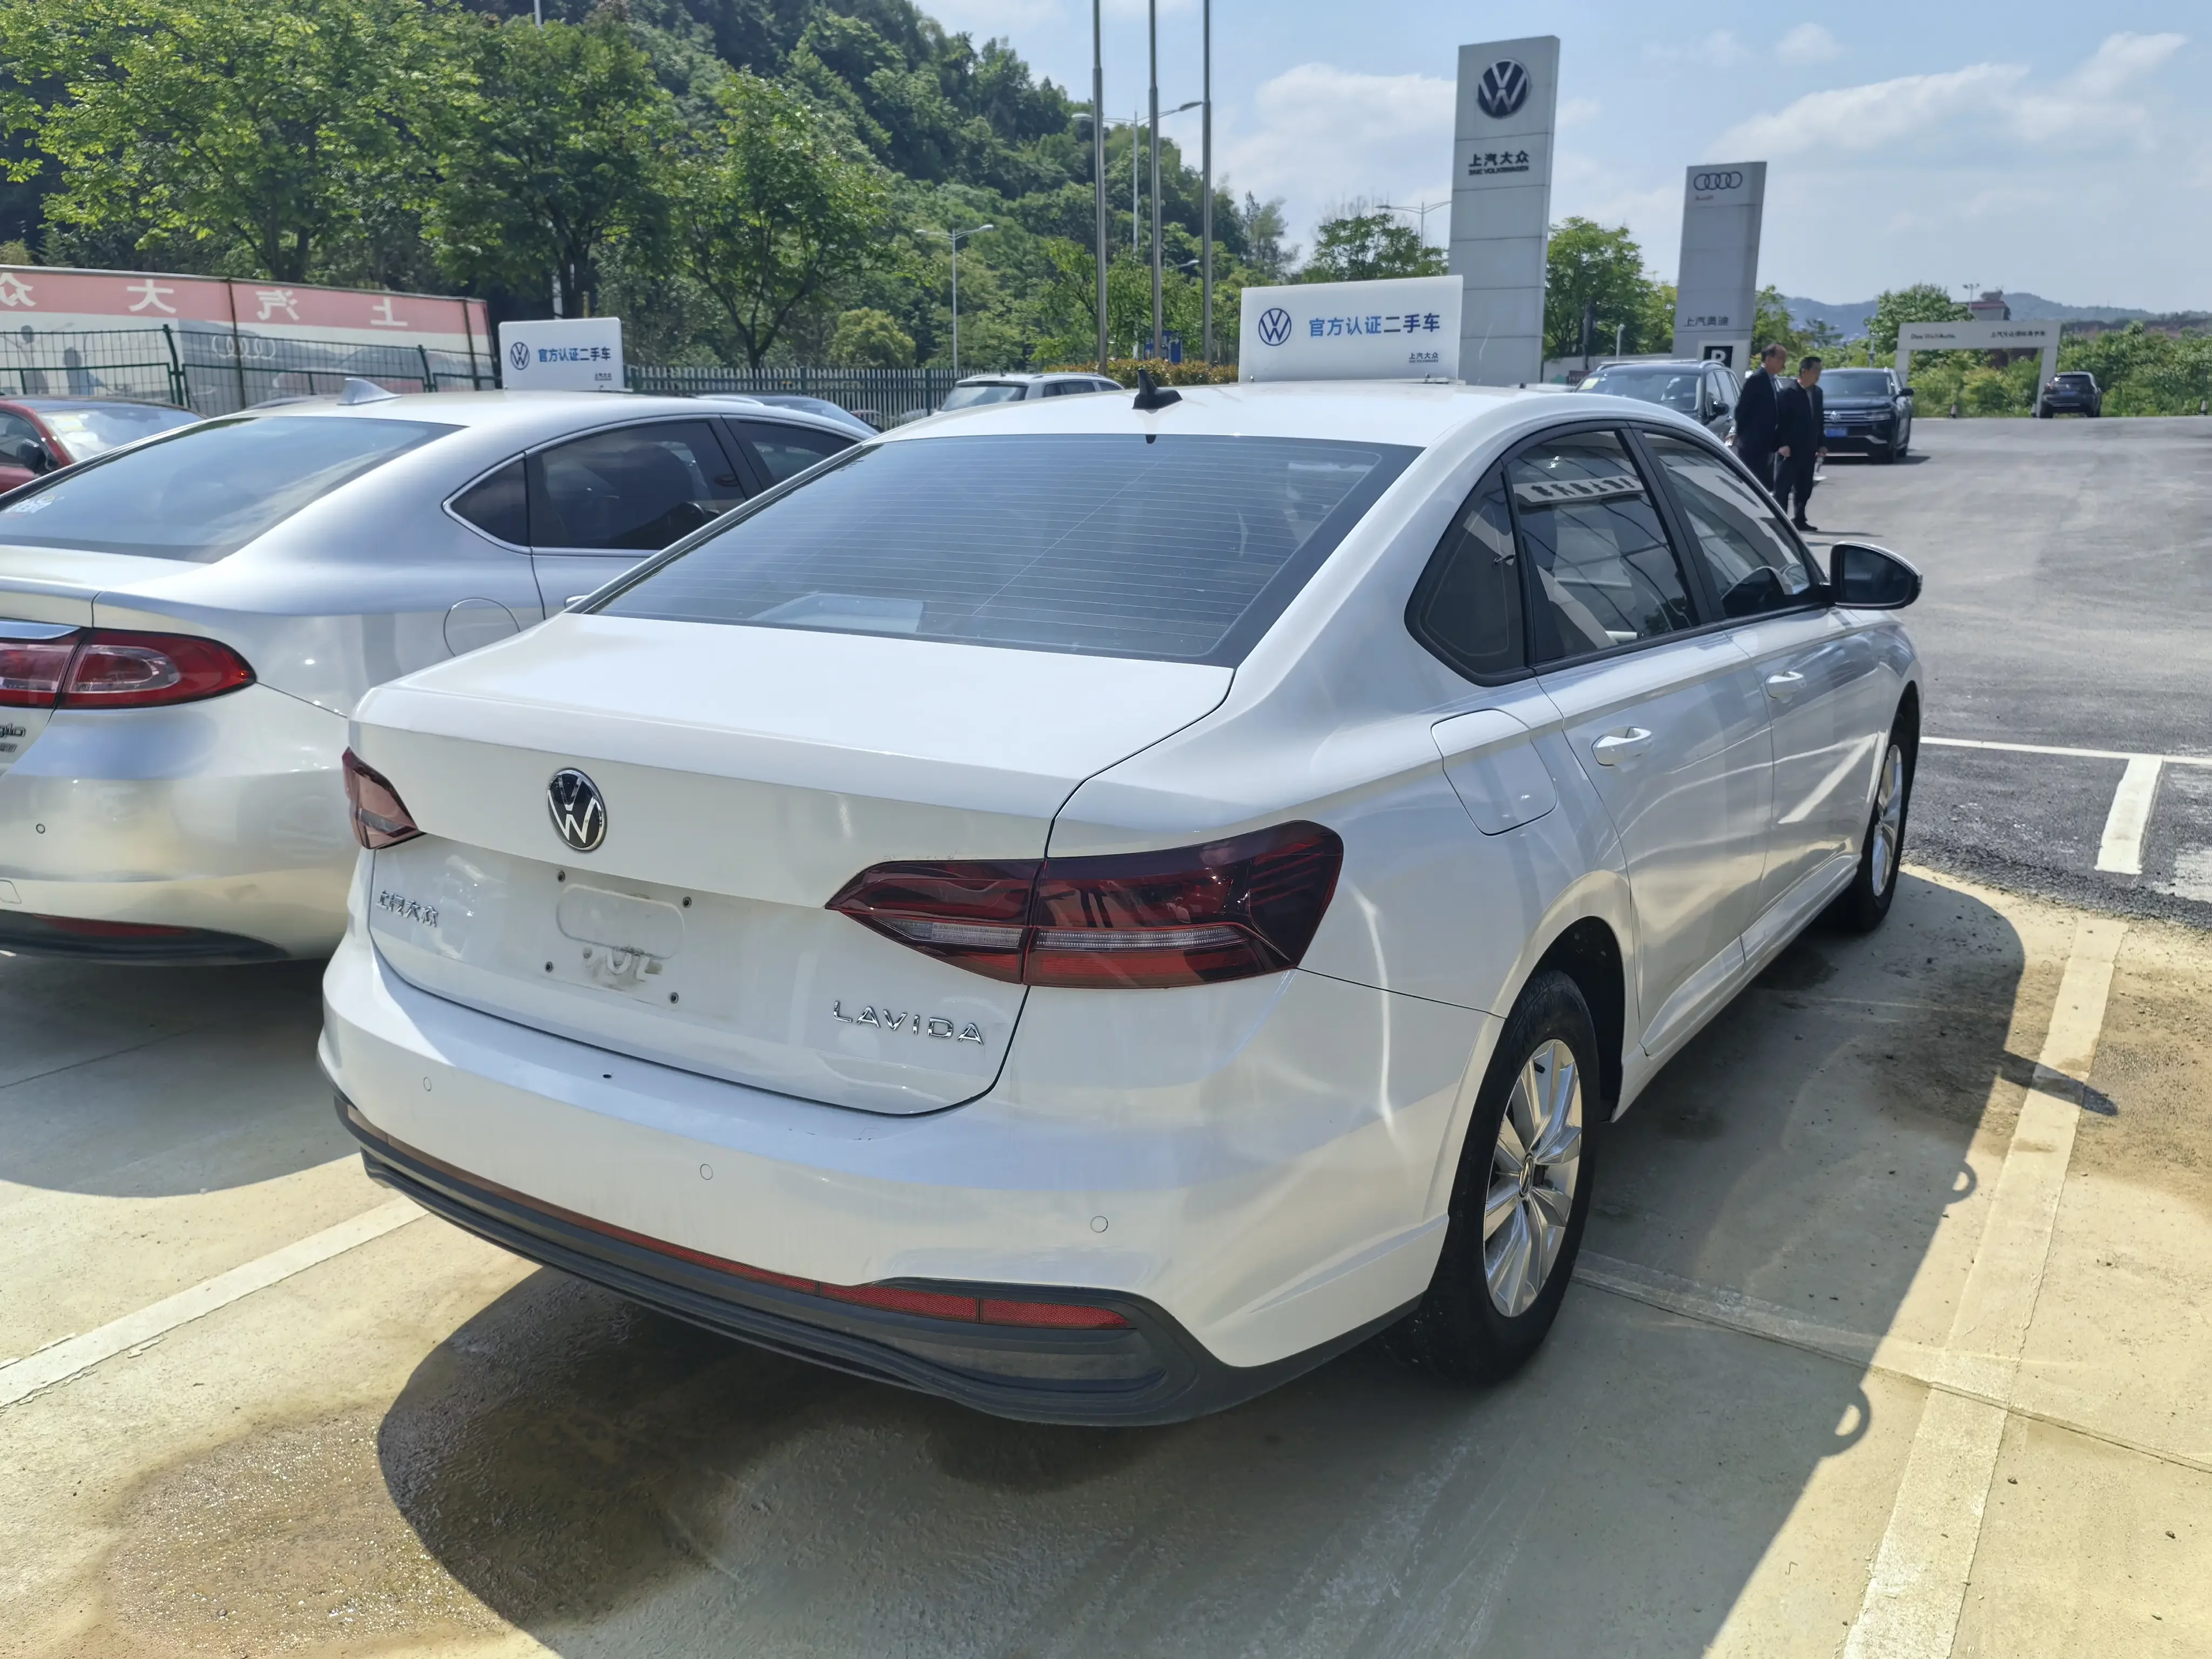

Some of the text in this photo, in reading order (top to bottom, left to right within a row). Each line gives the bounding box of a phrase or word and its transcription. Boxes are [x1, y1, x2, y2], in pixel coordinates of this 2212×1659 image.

[1468, 150, 1529, 167] 上汽大众
[1309, 312, 1441, 338] 官方认证二手车
[1683, 315, 1729, 327] 上汽奥迪
[538, 346, 611, 363] 官方认证二手车
[375, 889, 439, 928] 上汽大众
[833, 1000, 984, 1046] LAVIDA
